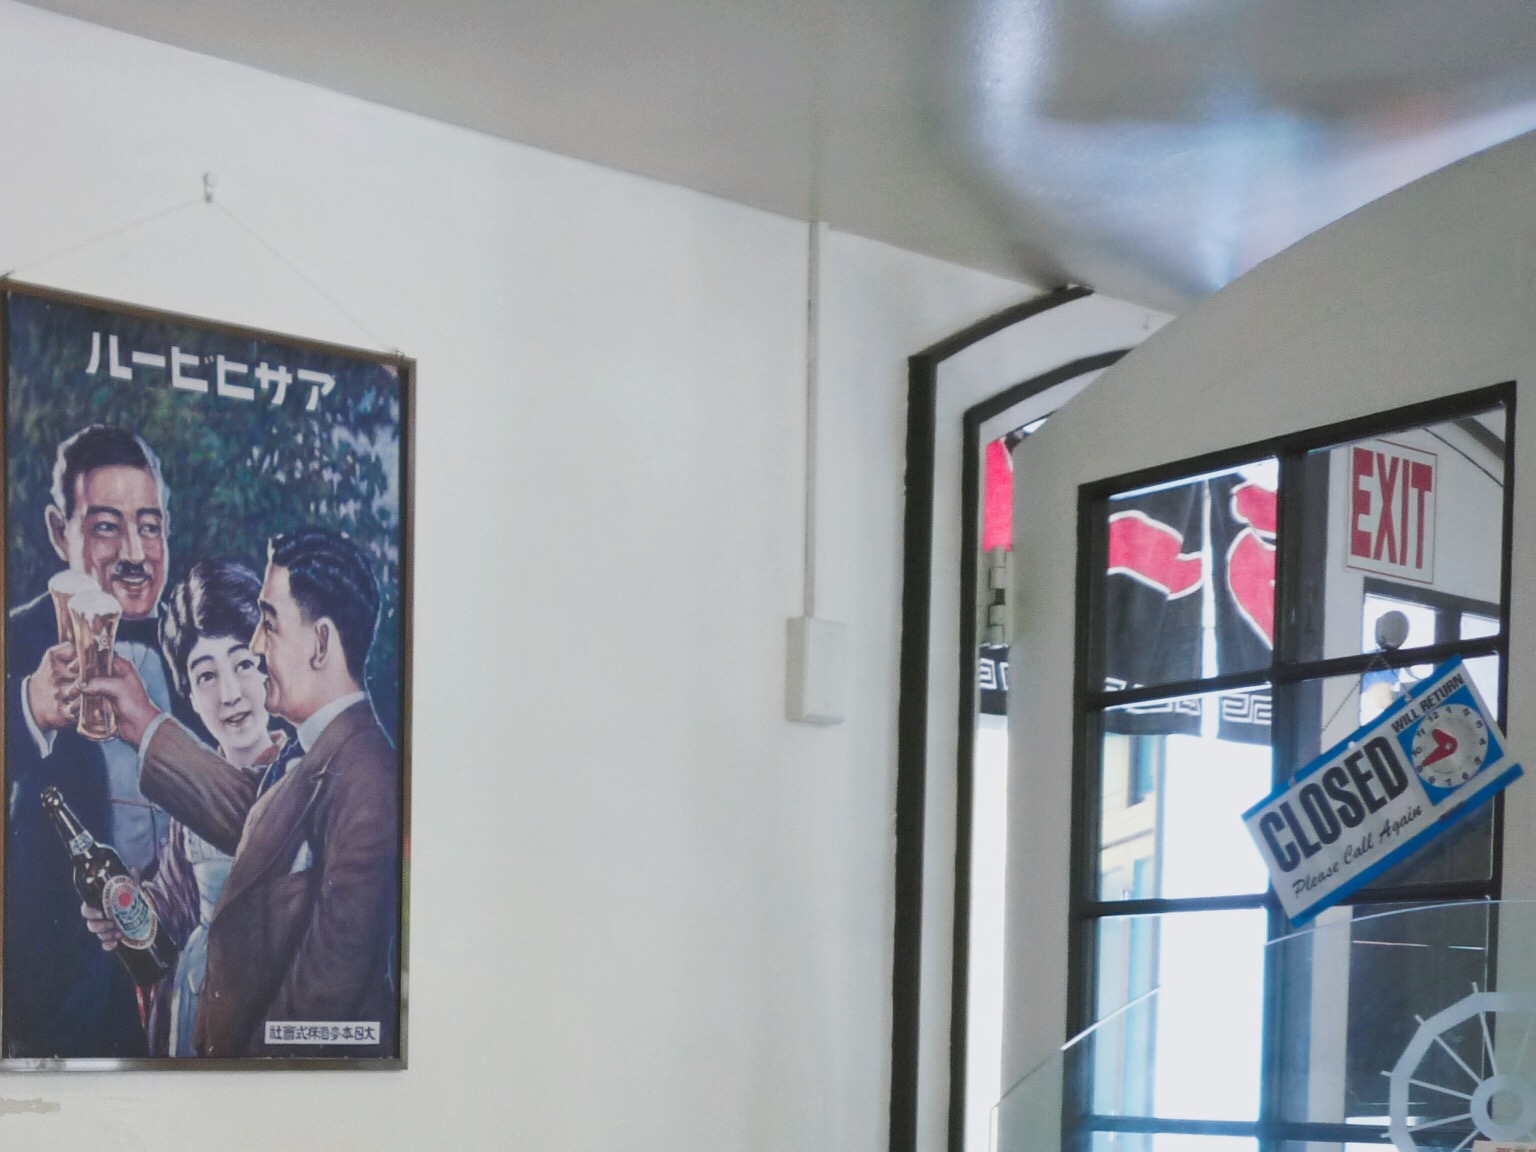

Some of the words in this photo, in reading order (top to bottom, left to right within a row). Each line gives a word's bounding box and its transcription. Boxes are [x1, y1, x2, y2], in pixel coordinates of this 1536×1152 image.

[1351, 446, 1433, 570] EXIT
[1391, 708, 1419, 733] WILL
[1419, 673, 1465, 713] RETURN
[1259, 736, 1409, 872] CLOSED
[1292, 861, 1340, 898] Please
[1344, 832, 1375, 865] Call
[1379, 805, 1423, 844] Again
